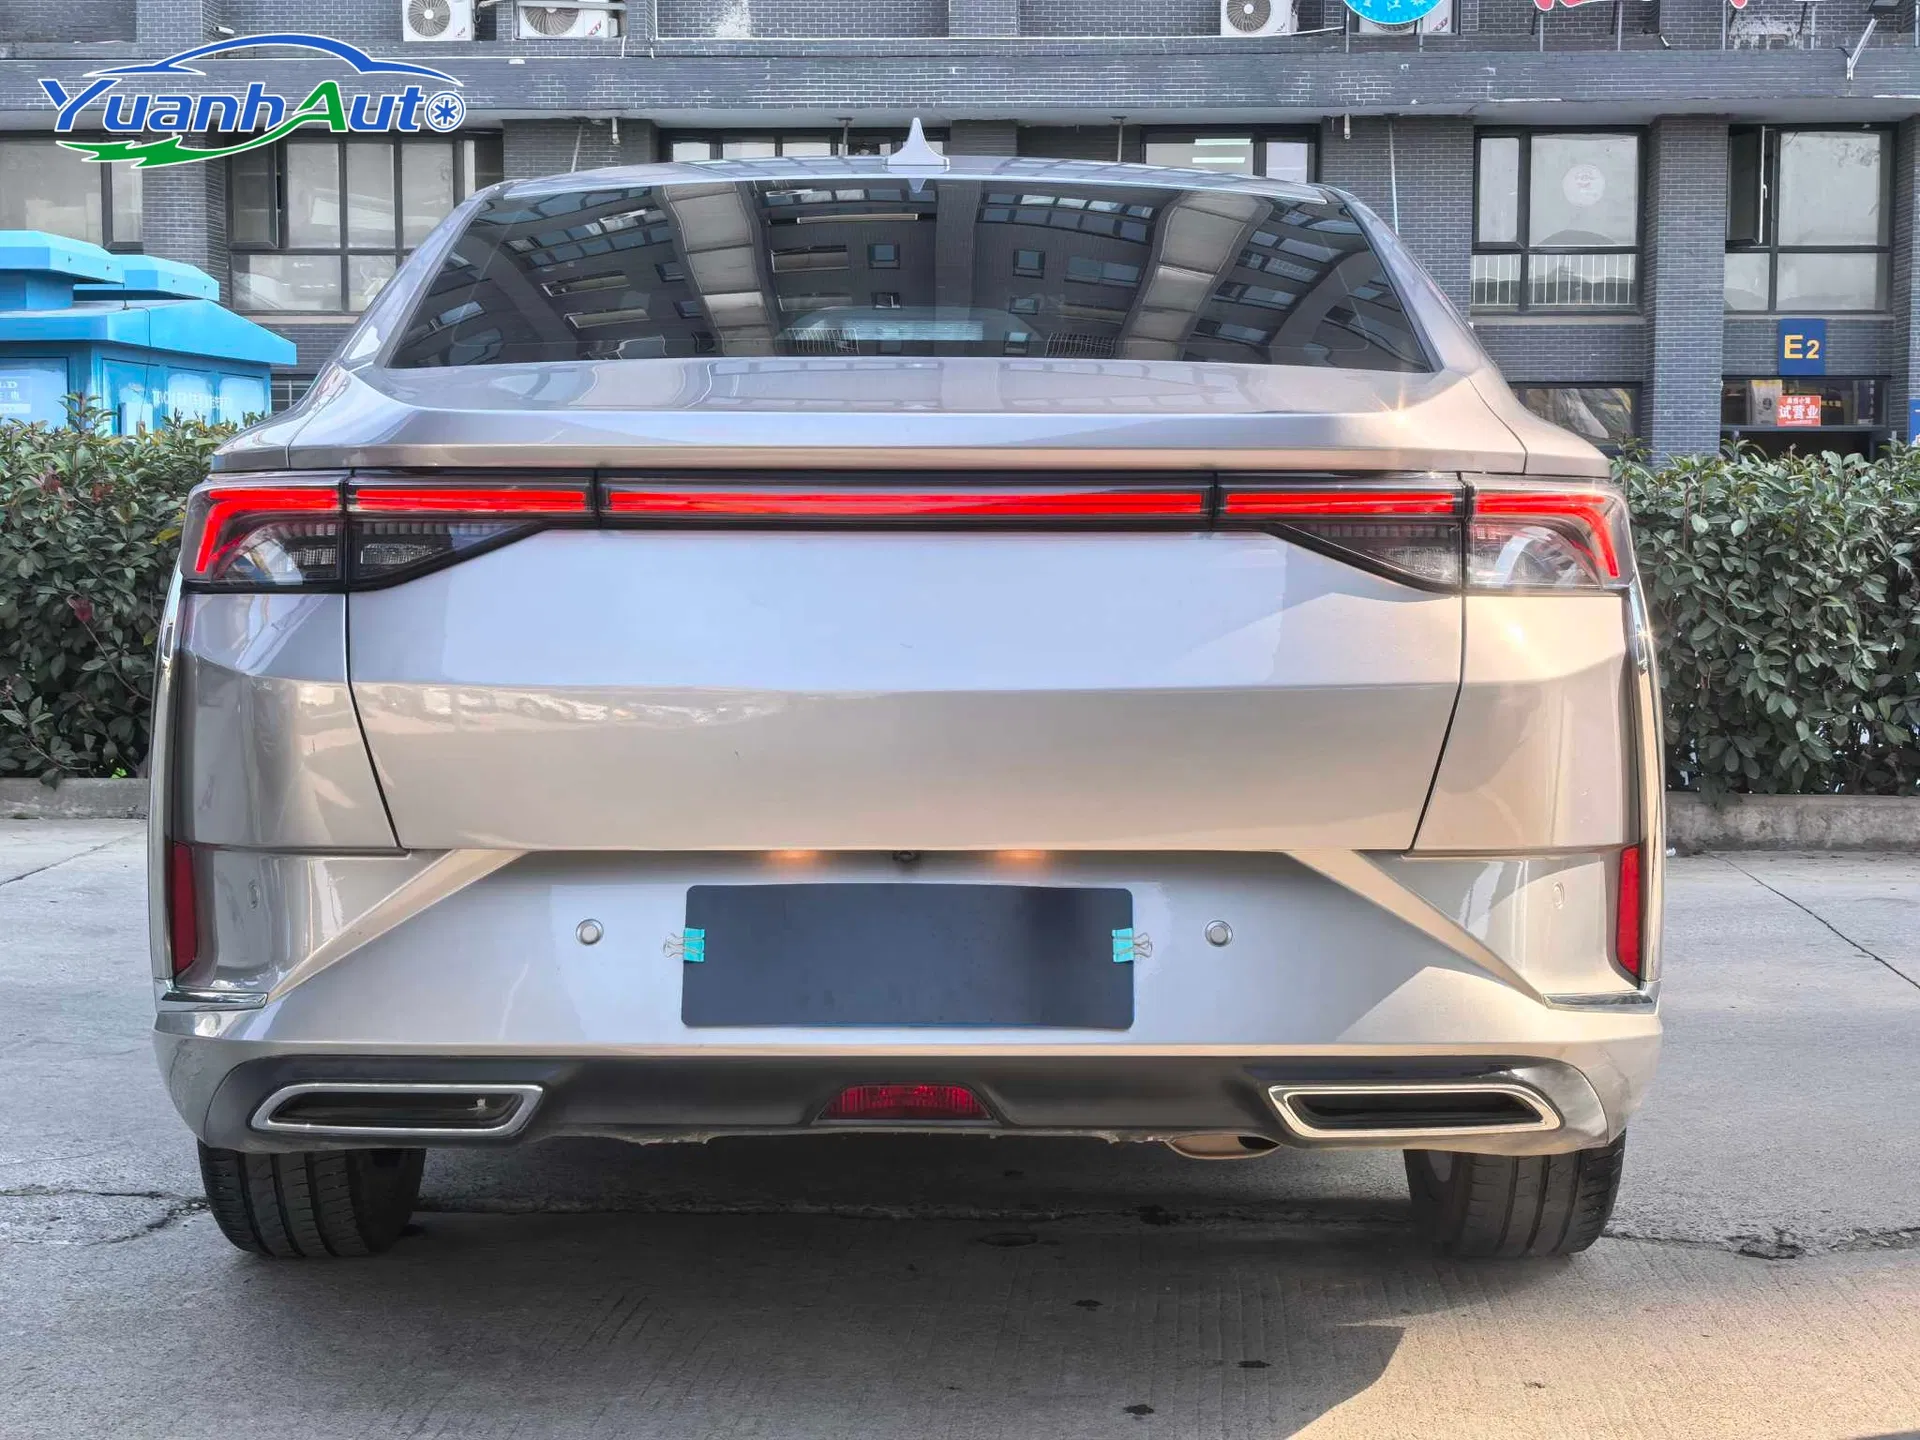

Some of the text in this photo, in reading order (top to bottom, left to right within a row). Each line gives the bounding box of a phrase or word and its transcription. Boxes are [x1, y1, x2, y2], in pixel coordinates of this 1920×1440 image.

[1783, 334, 1820, 359] E2
[1778, 404, 1819, 420] 试营业
